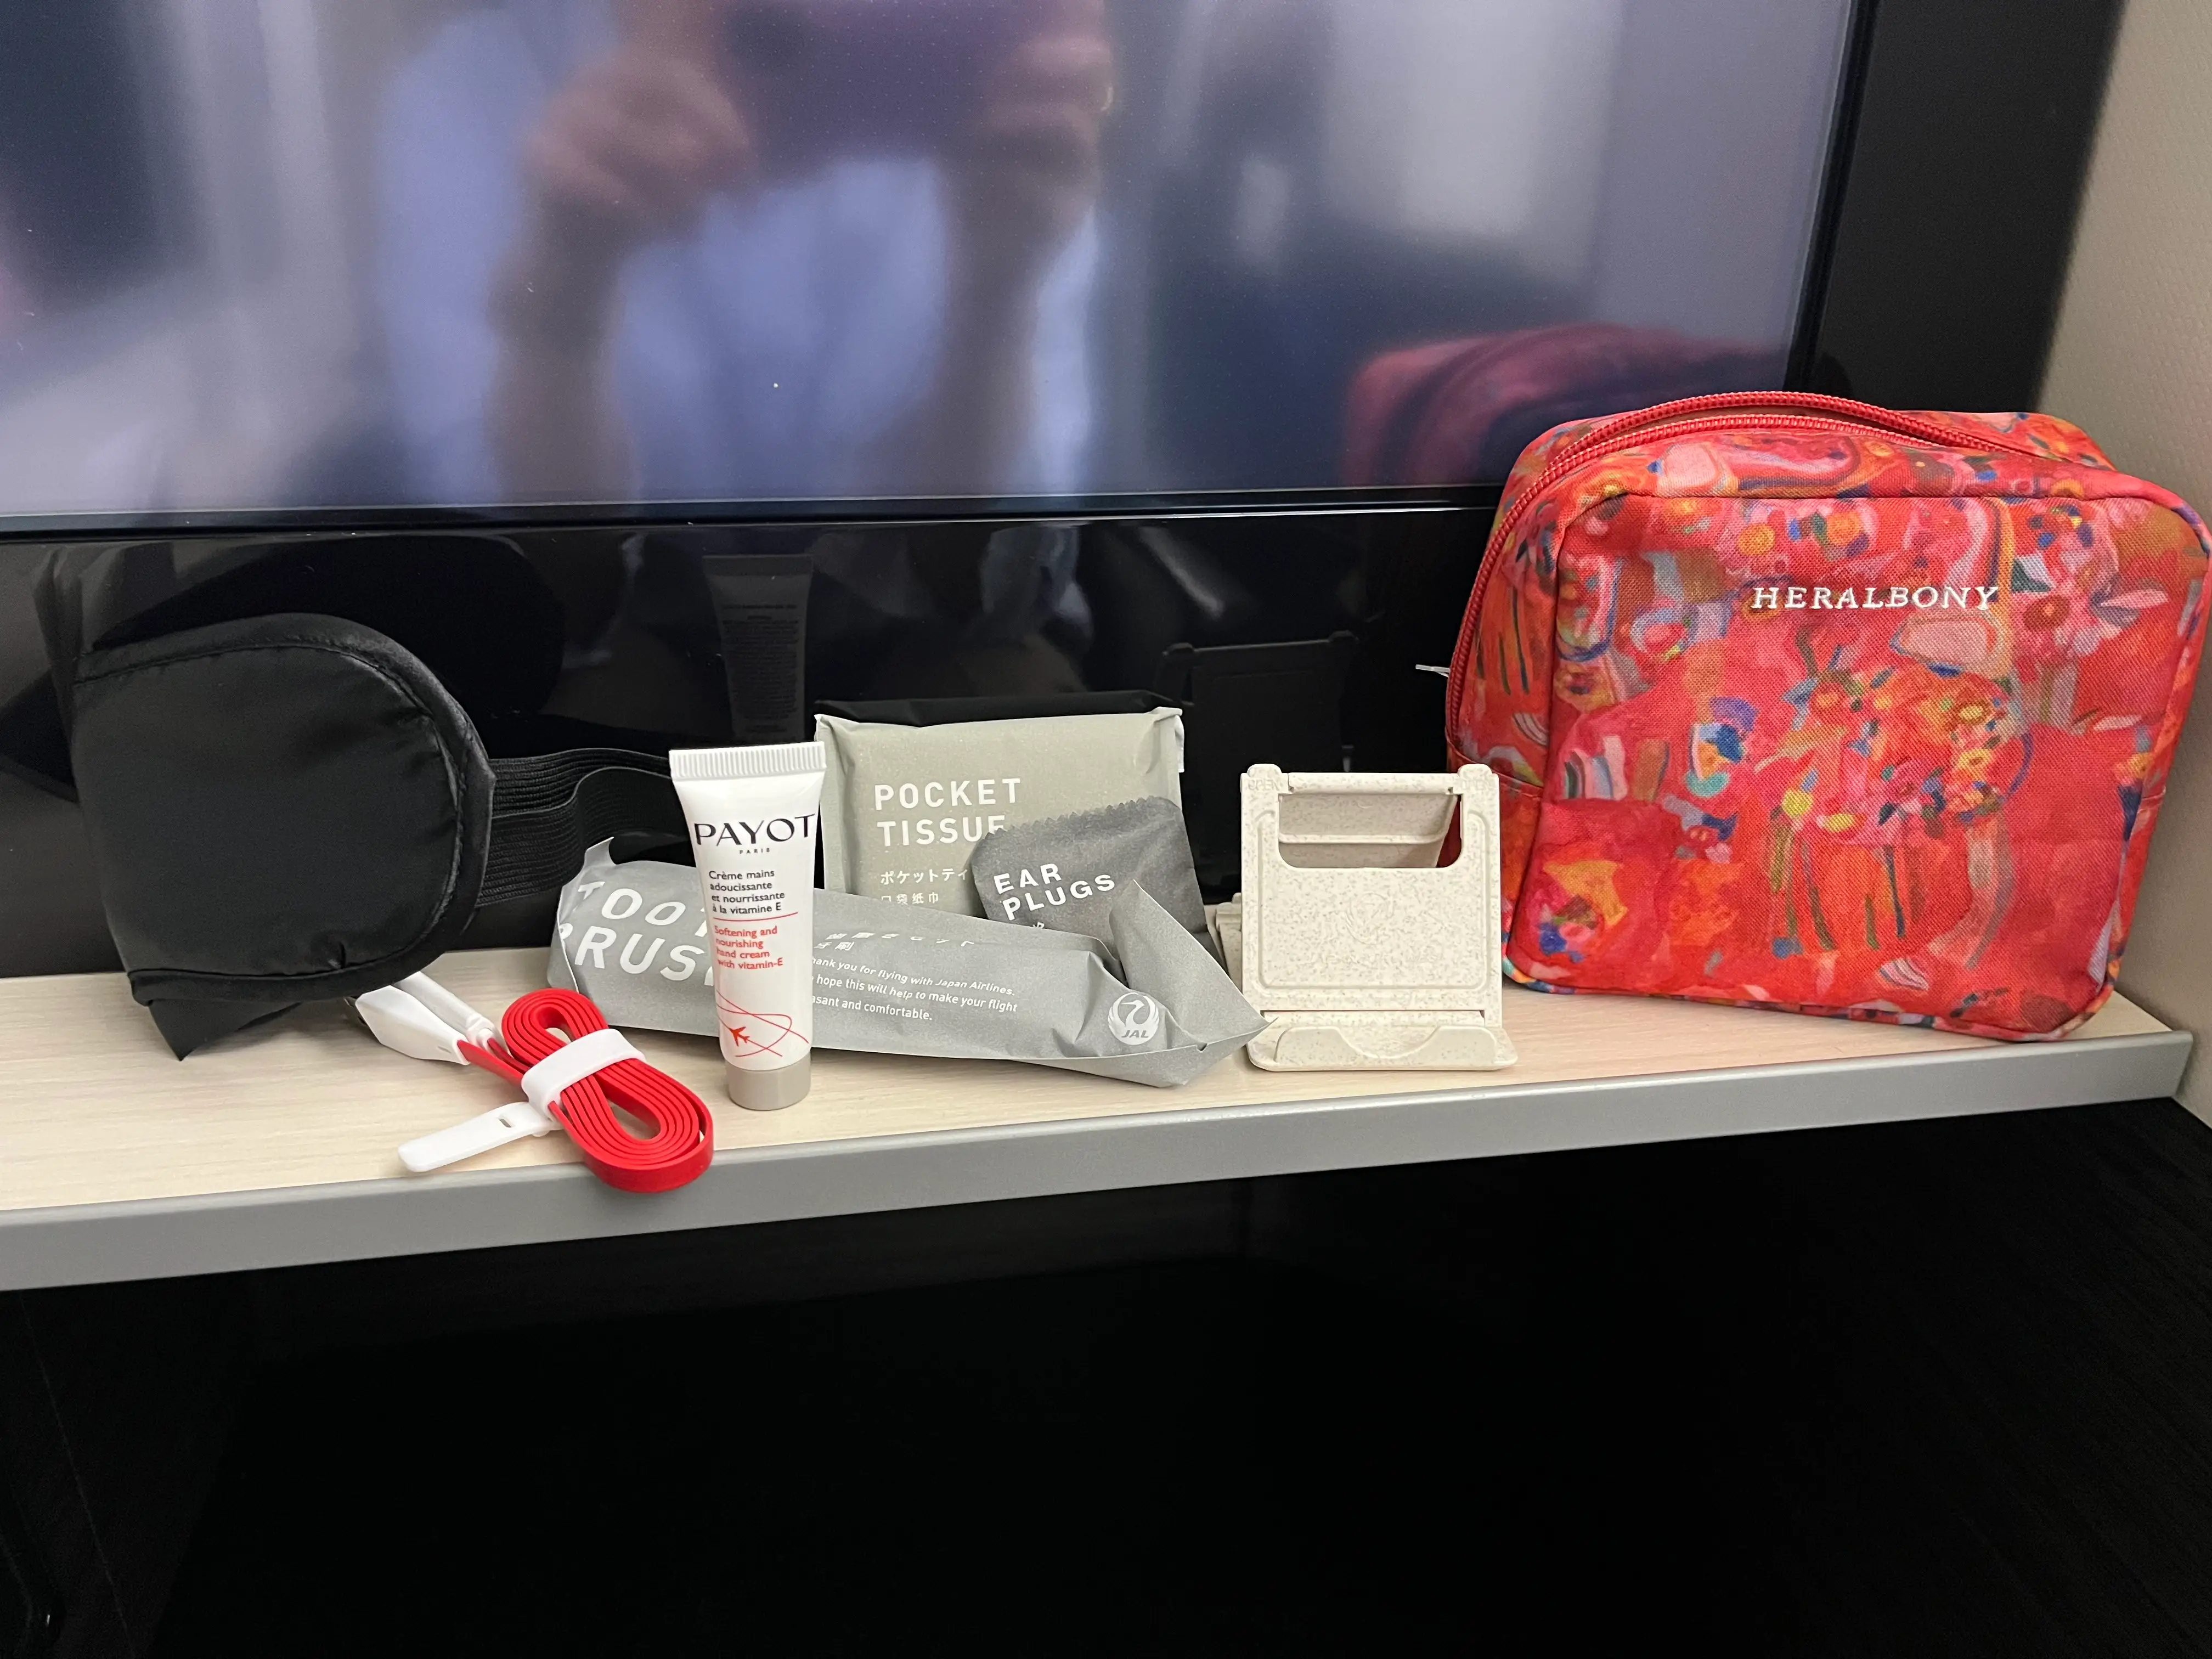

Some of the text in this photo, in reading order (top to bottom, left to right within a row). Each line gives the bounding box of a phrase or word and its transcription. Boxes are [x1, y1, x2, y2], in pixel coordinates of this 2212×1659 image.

[1750, 586, 1998, 611] HERALBONY
[874, 778, 1020, 810] POCKET
[694, 813, 816, 847] PAYOT
[709, 870, 775, 880] Crème mains
[994, 864, 1062, 894] EAR
[710, 882, 772, 891] adoucissante
[723, 892, 785, 903] nourrissante
[1002, 874, 1115, 921] PLUGS
[713, 902, 782, 914] à la vitamine E
[714, 926, 777, 939] Softening and
[715, 938, 764, 949] nourishing
[717, 946, 736, 958] hand
[718, 957, 783, 969] with vitamin-E
[837, 962, 857, 971] you
[860, 965, 876, 975] for
[878, 969, 909, 984] flying
[911, 977, 933, 986] with
[935, 979, 967, 988] Japan
[969, 981, 1015, 996] Airlines.
[816, 974, 843, 988] hope
[845, 979, 866, 991] this
[868, 983, 888, 994] will
[889, 986, 913, 1000] help
[915, 991, 926, 1000] to
[928, 992, 958, 1004] make
[960, 997, 986, 1007] your
[988, 998, 1018, 1013] flight
[842, 1000, 861, 1011] and
[864, 1004, 933, 1020] comfortable.
[1121, 1030, 1149, 1038] JAL
